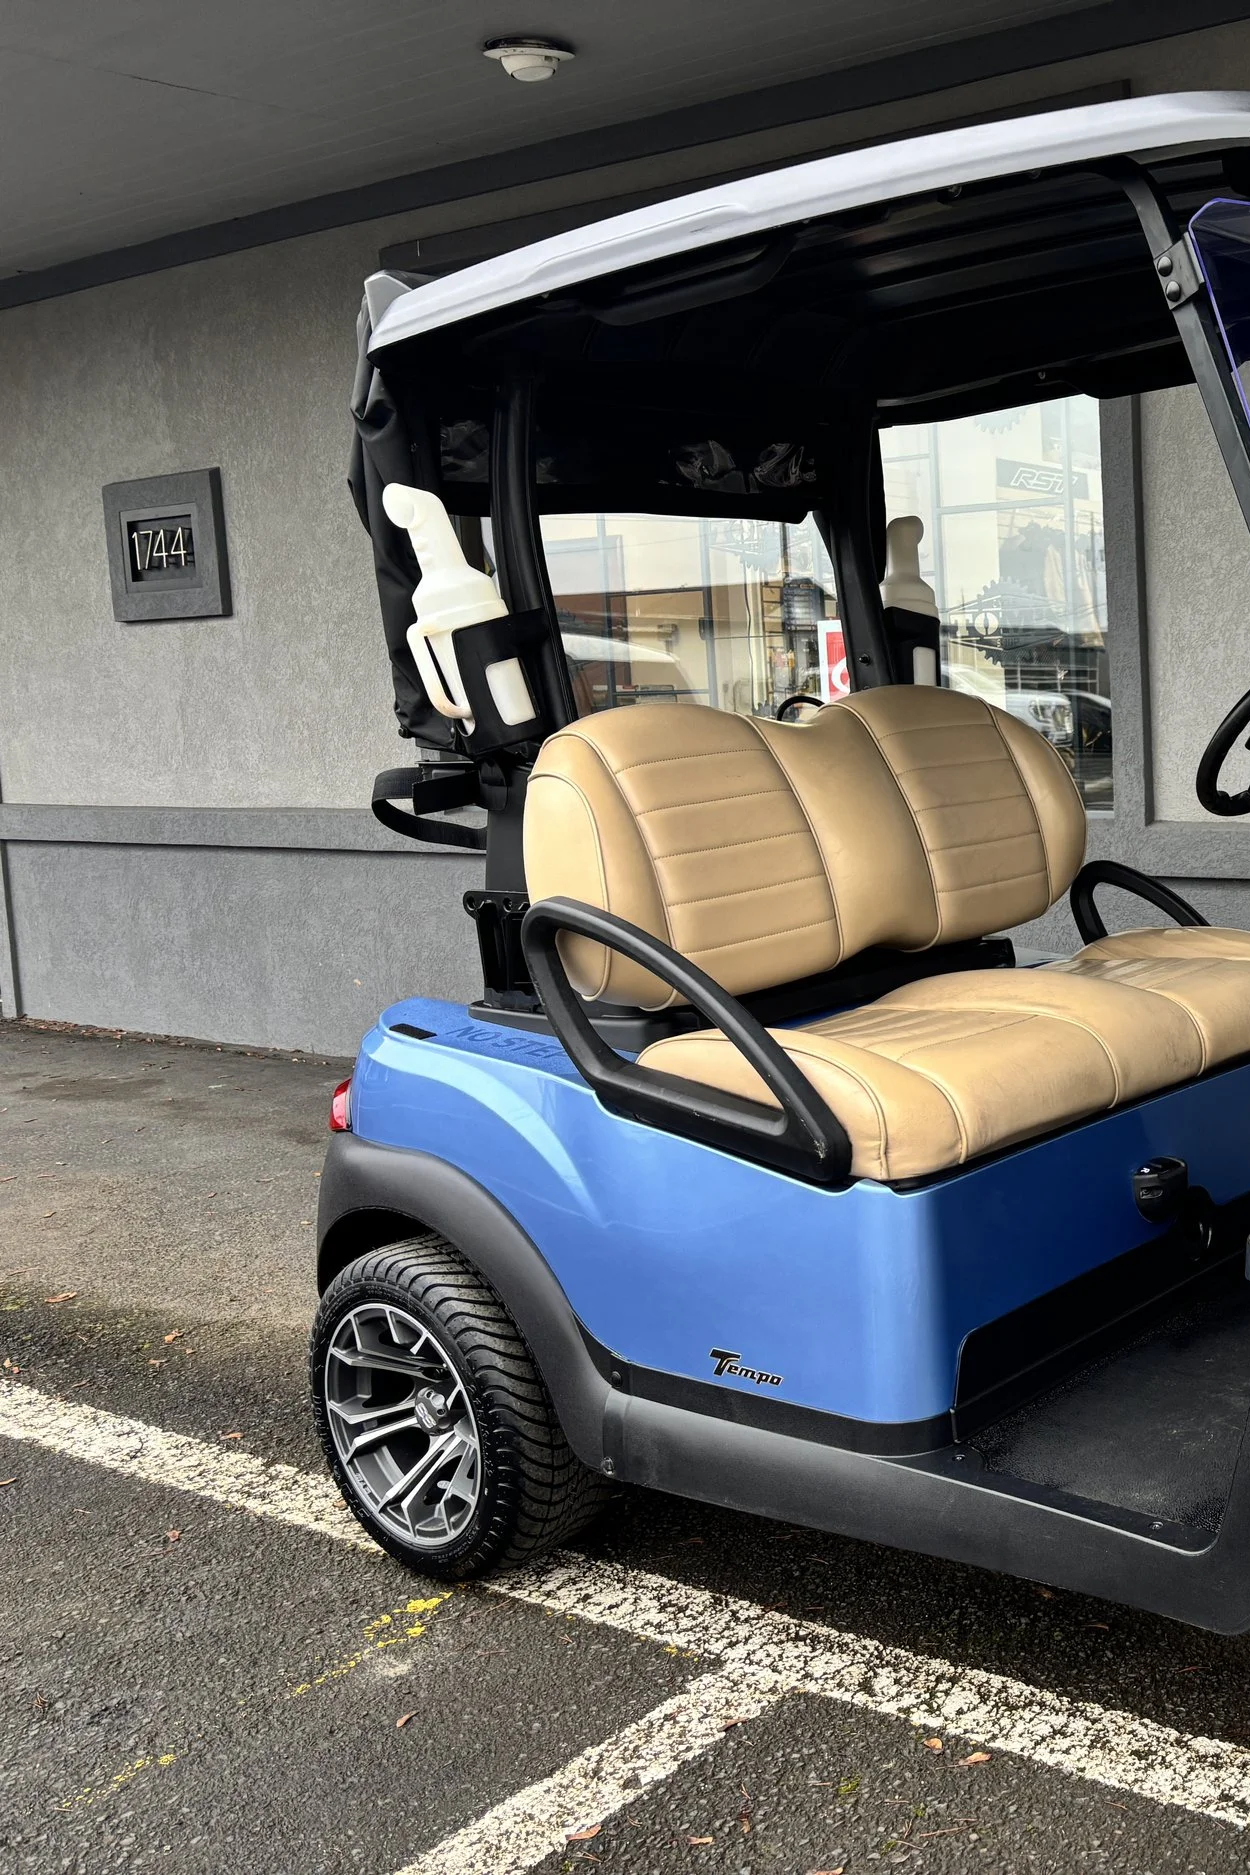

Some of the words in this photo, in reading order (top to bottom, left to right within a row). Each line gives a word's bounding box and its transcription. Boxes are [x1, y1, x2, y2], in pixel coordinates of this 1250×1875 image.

[131, 526, 187, 571] 1744
[446, 1025, 502, 1042] NO
[492, 1036, 566, 1059] STEP
[709, 1347, 784, 1386] Tempo
